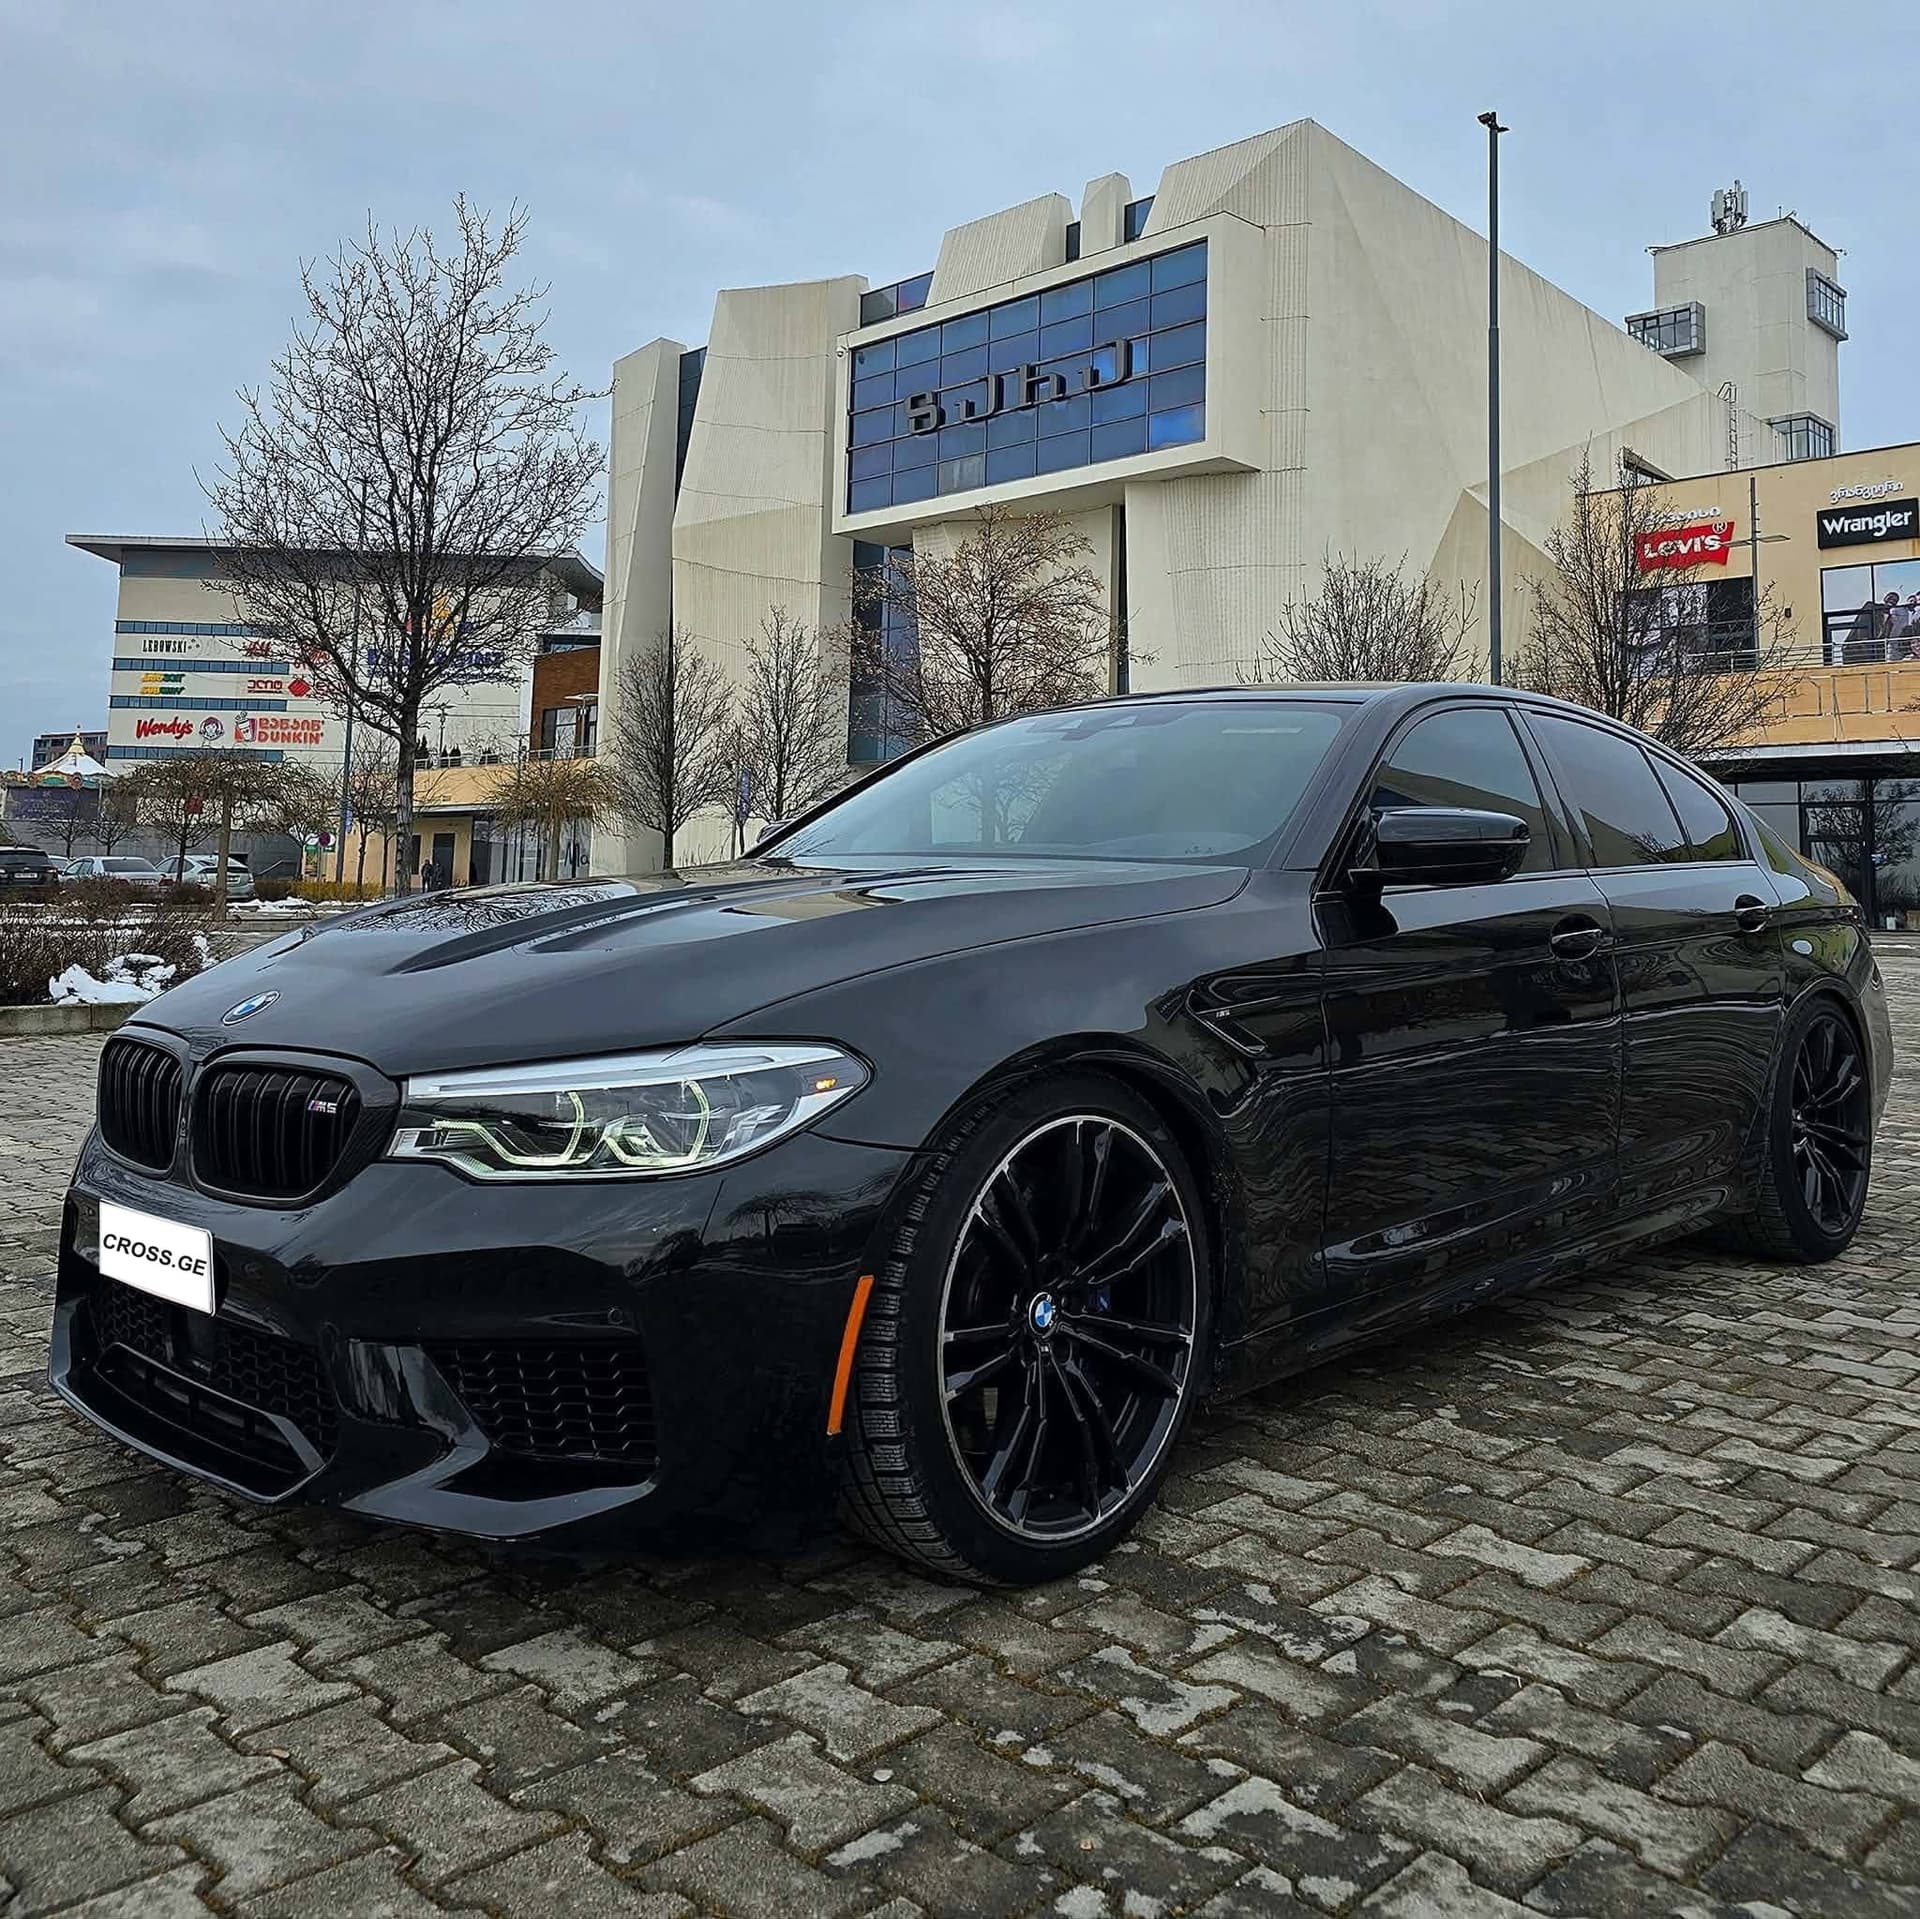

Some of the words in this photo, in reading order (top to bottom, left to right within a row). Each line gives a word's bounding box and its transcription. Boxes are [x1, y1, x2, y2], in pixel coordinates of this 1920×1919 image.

[1822, 510, 1912, 537] Wrangler
[142, 639, 188, 654] LEBOWSKI
[135, 716, 193, 739] Wendy's
[102, 1233, 208, 1277] CROSS.GE
